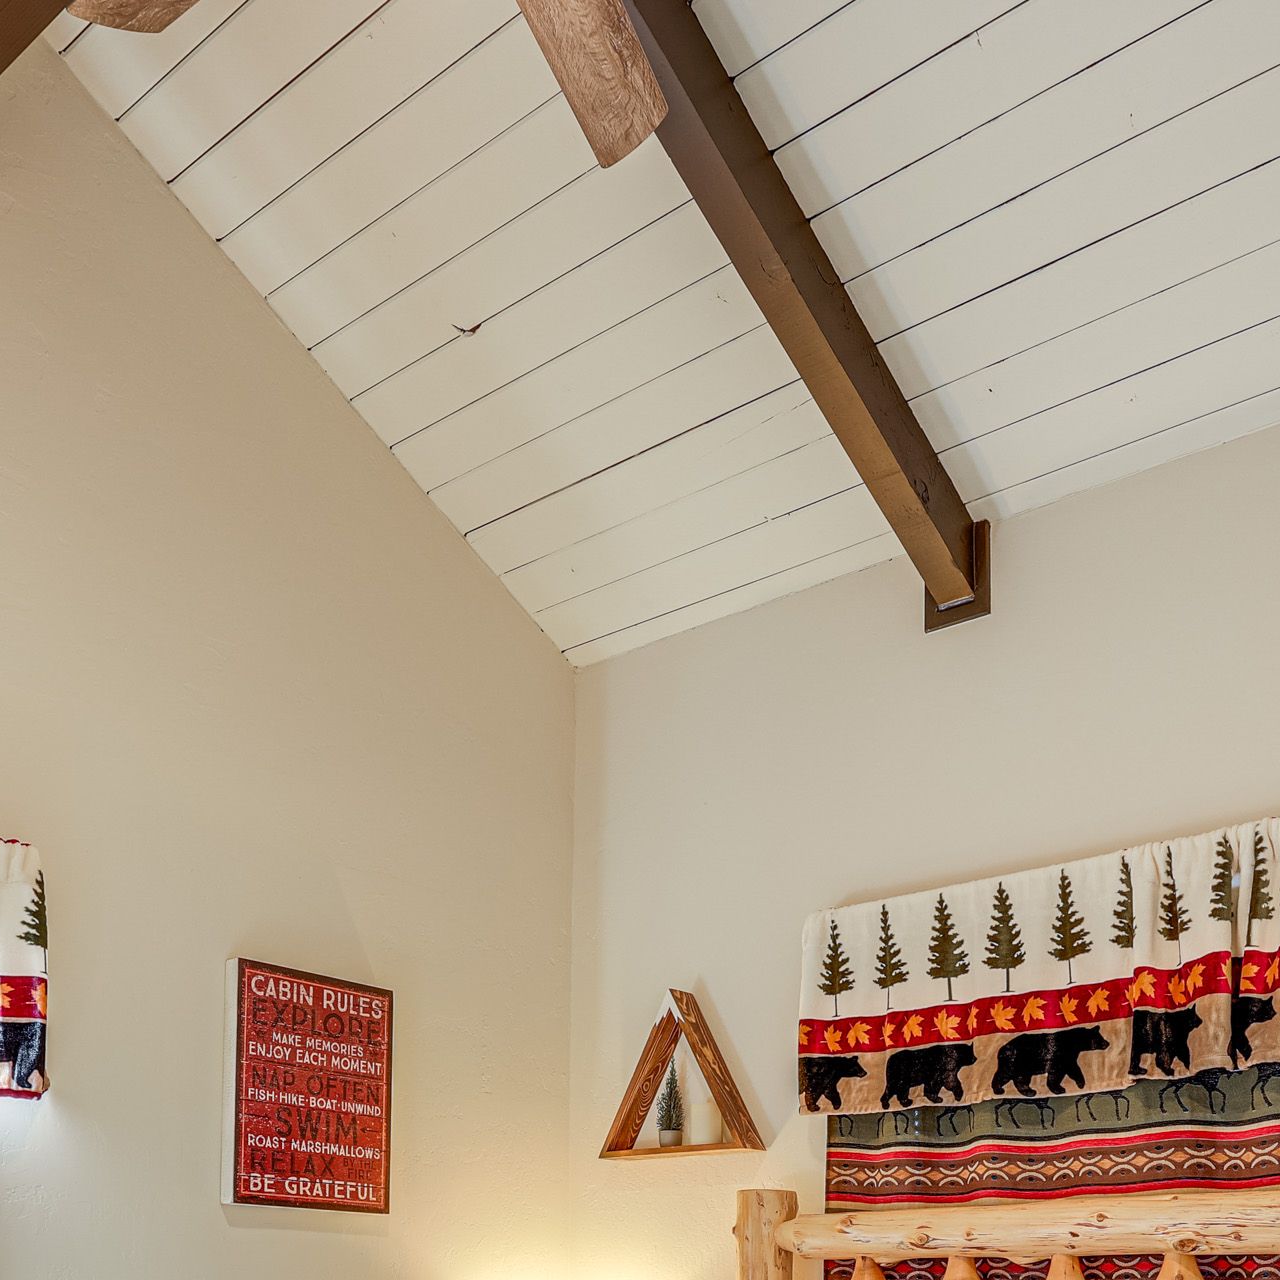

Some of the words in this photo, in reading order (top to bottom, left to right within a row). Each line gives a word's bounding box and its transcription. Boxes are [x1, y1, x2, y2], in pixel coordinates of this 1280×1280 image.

[251, 975, 314, 1006] CABIN
[323, 989, 382, 1019] RULES
[252, 998, 380, 1047] EXPLORE
[248, 1041, 291, 1060] ENJOY
[296, 1049, 327, 1066] EACH
[331, 1055, 382, 1075] MOMENT
[272, 1031, 302, 1047] MAKE
[306, 1037, 364, 1057] MEMORIES
[251, 1065, 295, 1089] NAP
[307, 1075, 380, 1105] OFTEN
[275, 1107, 358, 1145] SWIM
[247, 1134, 287, 1149] ROAST
[291, 1138, 380, 1160] MARSHMALLOWS
[250, 1149, 335, 1178] RELAX
[343, 1157, 355, 1168] BY
[347, 1168, 373, 1180] FIRE
[249, 1173, 276, 1193] BE
[284, 1176, 377, 1201] GRATEFUL
